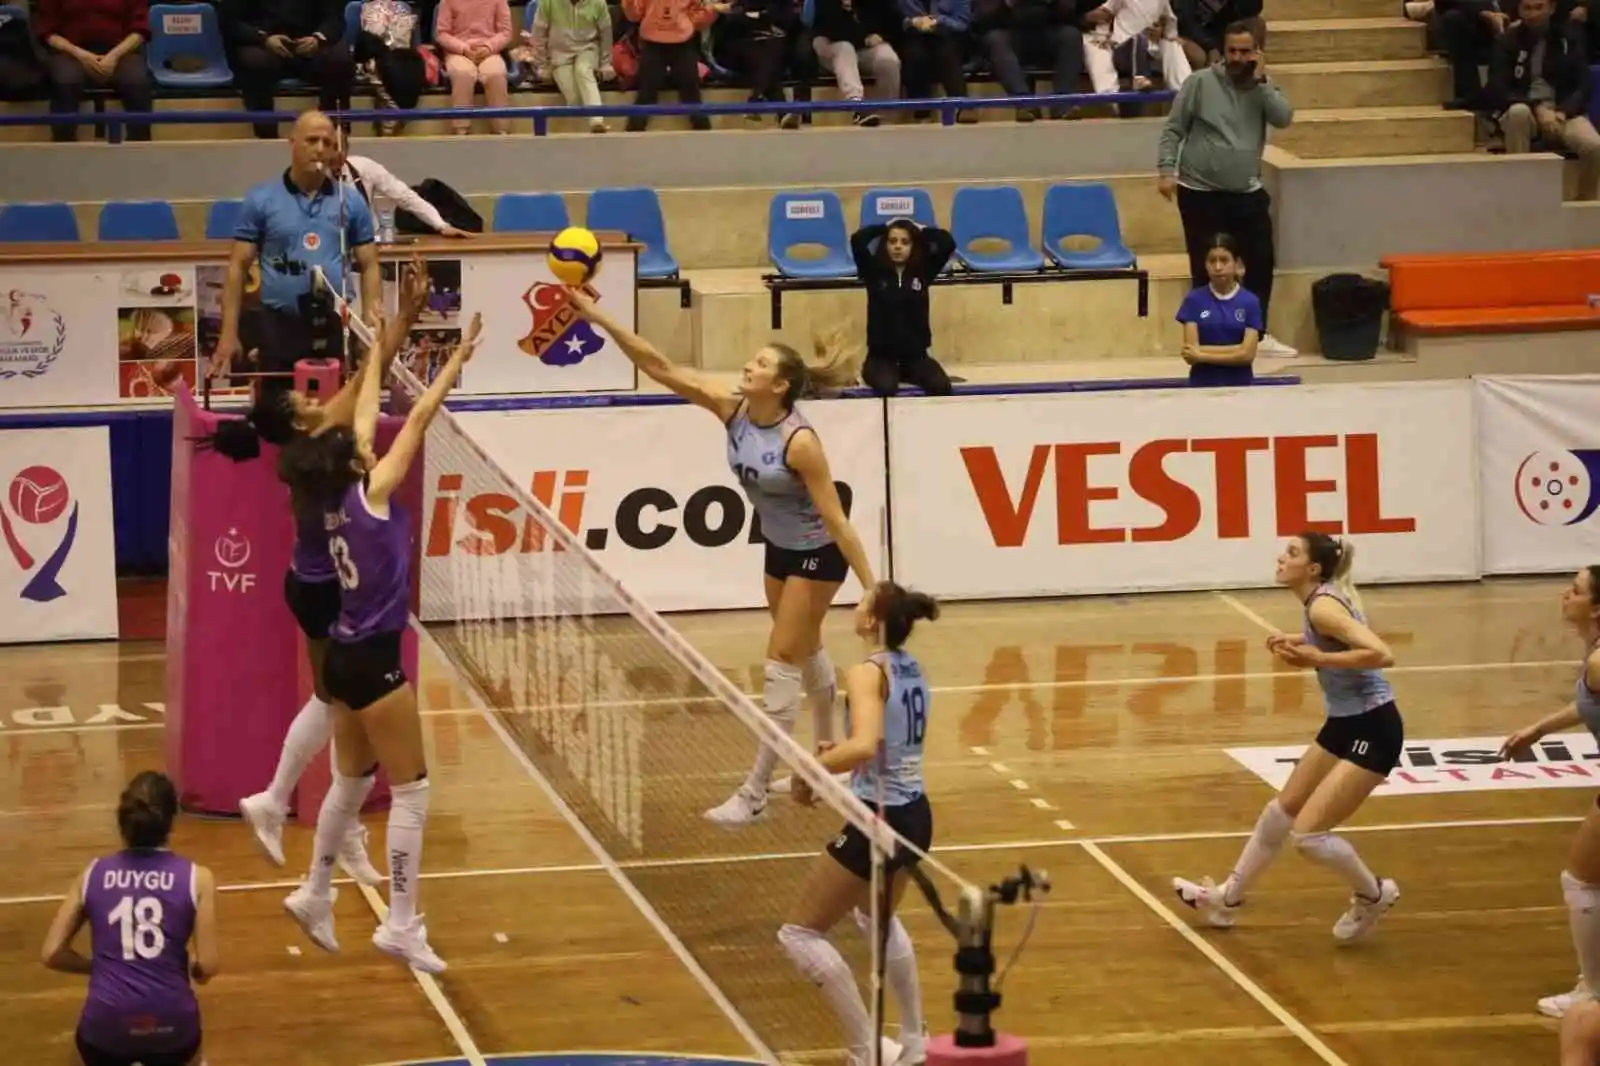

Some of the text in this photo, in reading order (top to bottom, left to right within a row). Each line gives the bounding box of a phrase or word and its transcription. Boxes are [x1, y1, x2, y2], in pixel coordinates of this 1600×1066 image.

[960, 433, 1416, 547] VESTEL
[802, 558, 819, 570] 16
[206, 570, 257, 593] TVF
[902, 686, 926, 747] 18
[1351, 738, 1369, 755] 10
[1384, 764, 1600, 786] LTAN
[103, 870, 175, 891] DUYGU
[108, 896, 165, 960] 18
